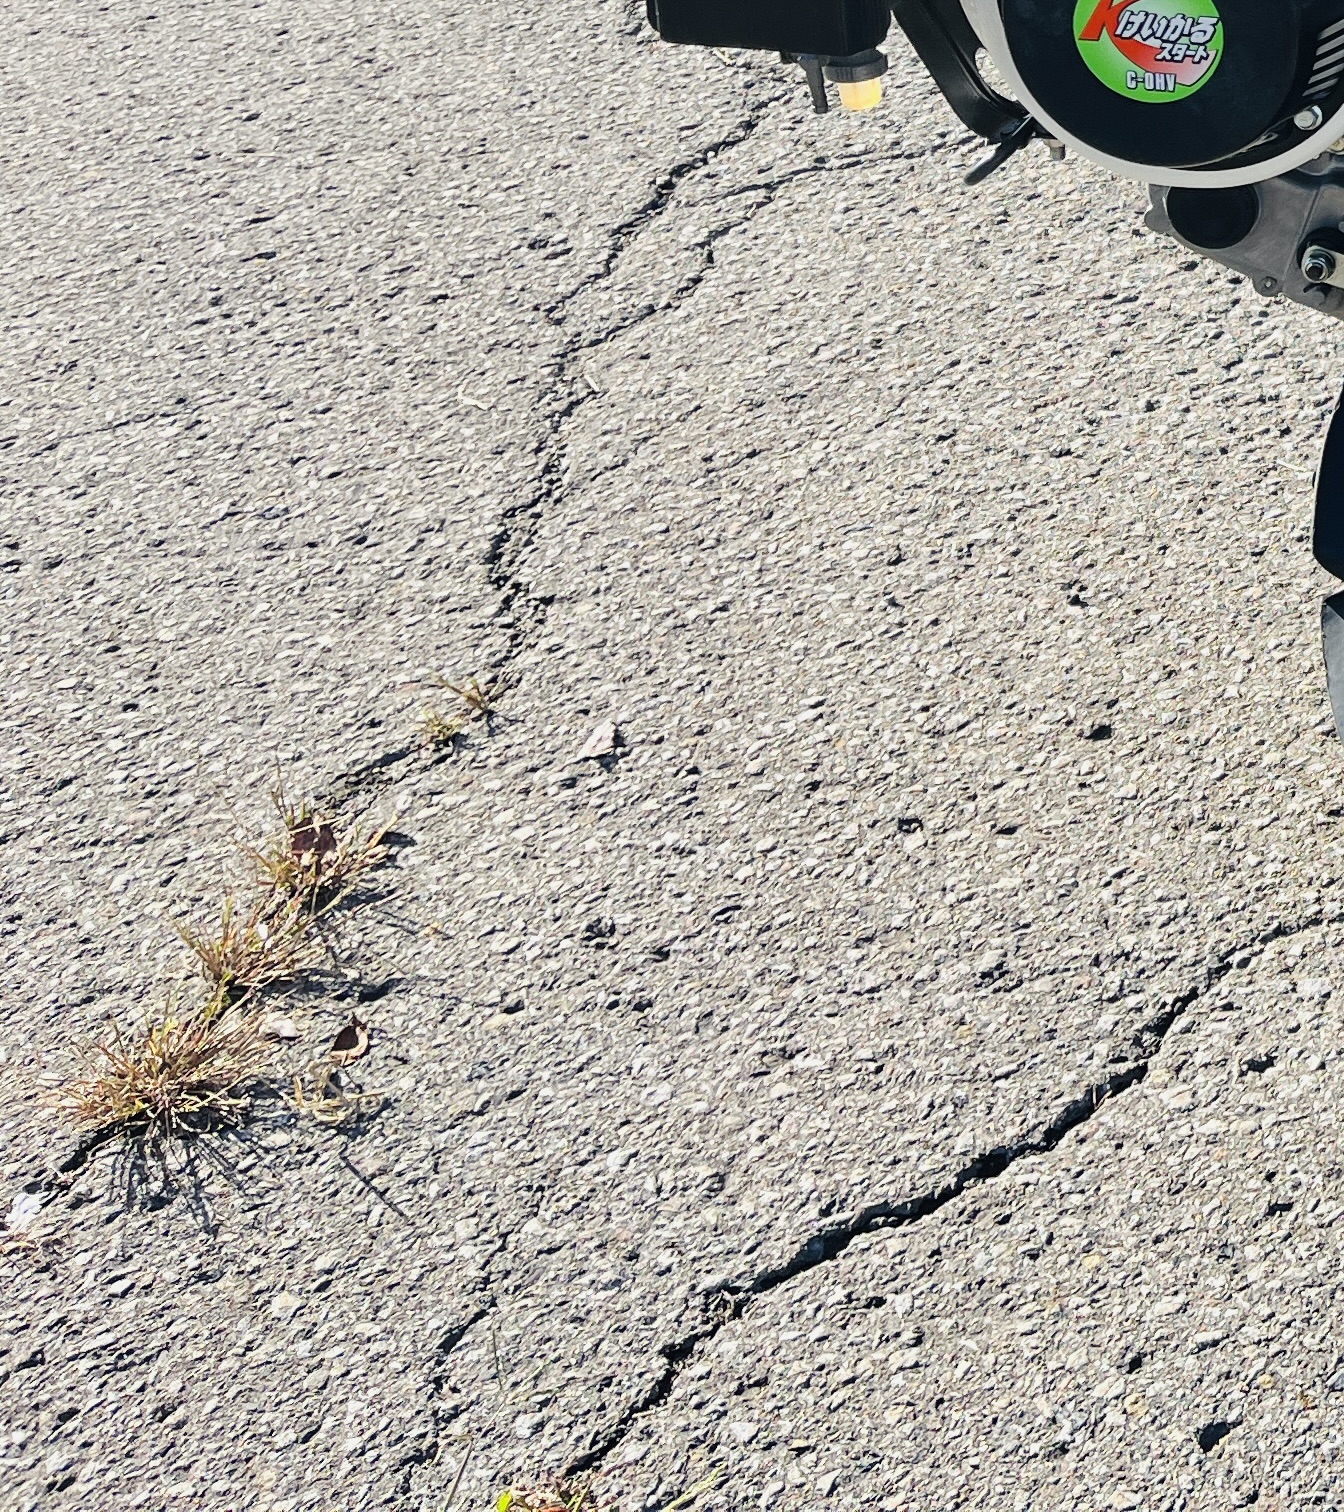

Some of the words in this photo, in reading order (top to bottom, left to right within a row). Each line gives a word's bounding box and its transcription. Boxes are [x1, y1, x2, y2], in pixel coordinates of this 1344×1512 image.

[1115, 10, 1220, 44] けいかる
[1155, 43, 1210, 64] スタート
